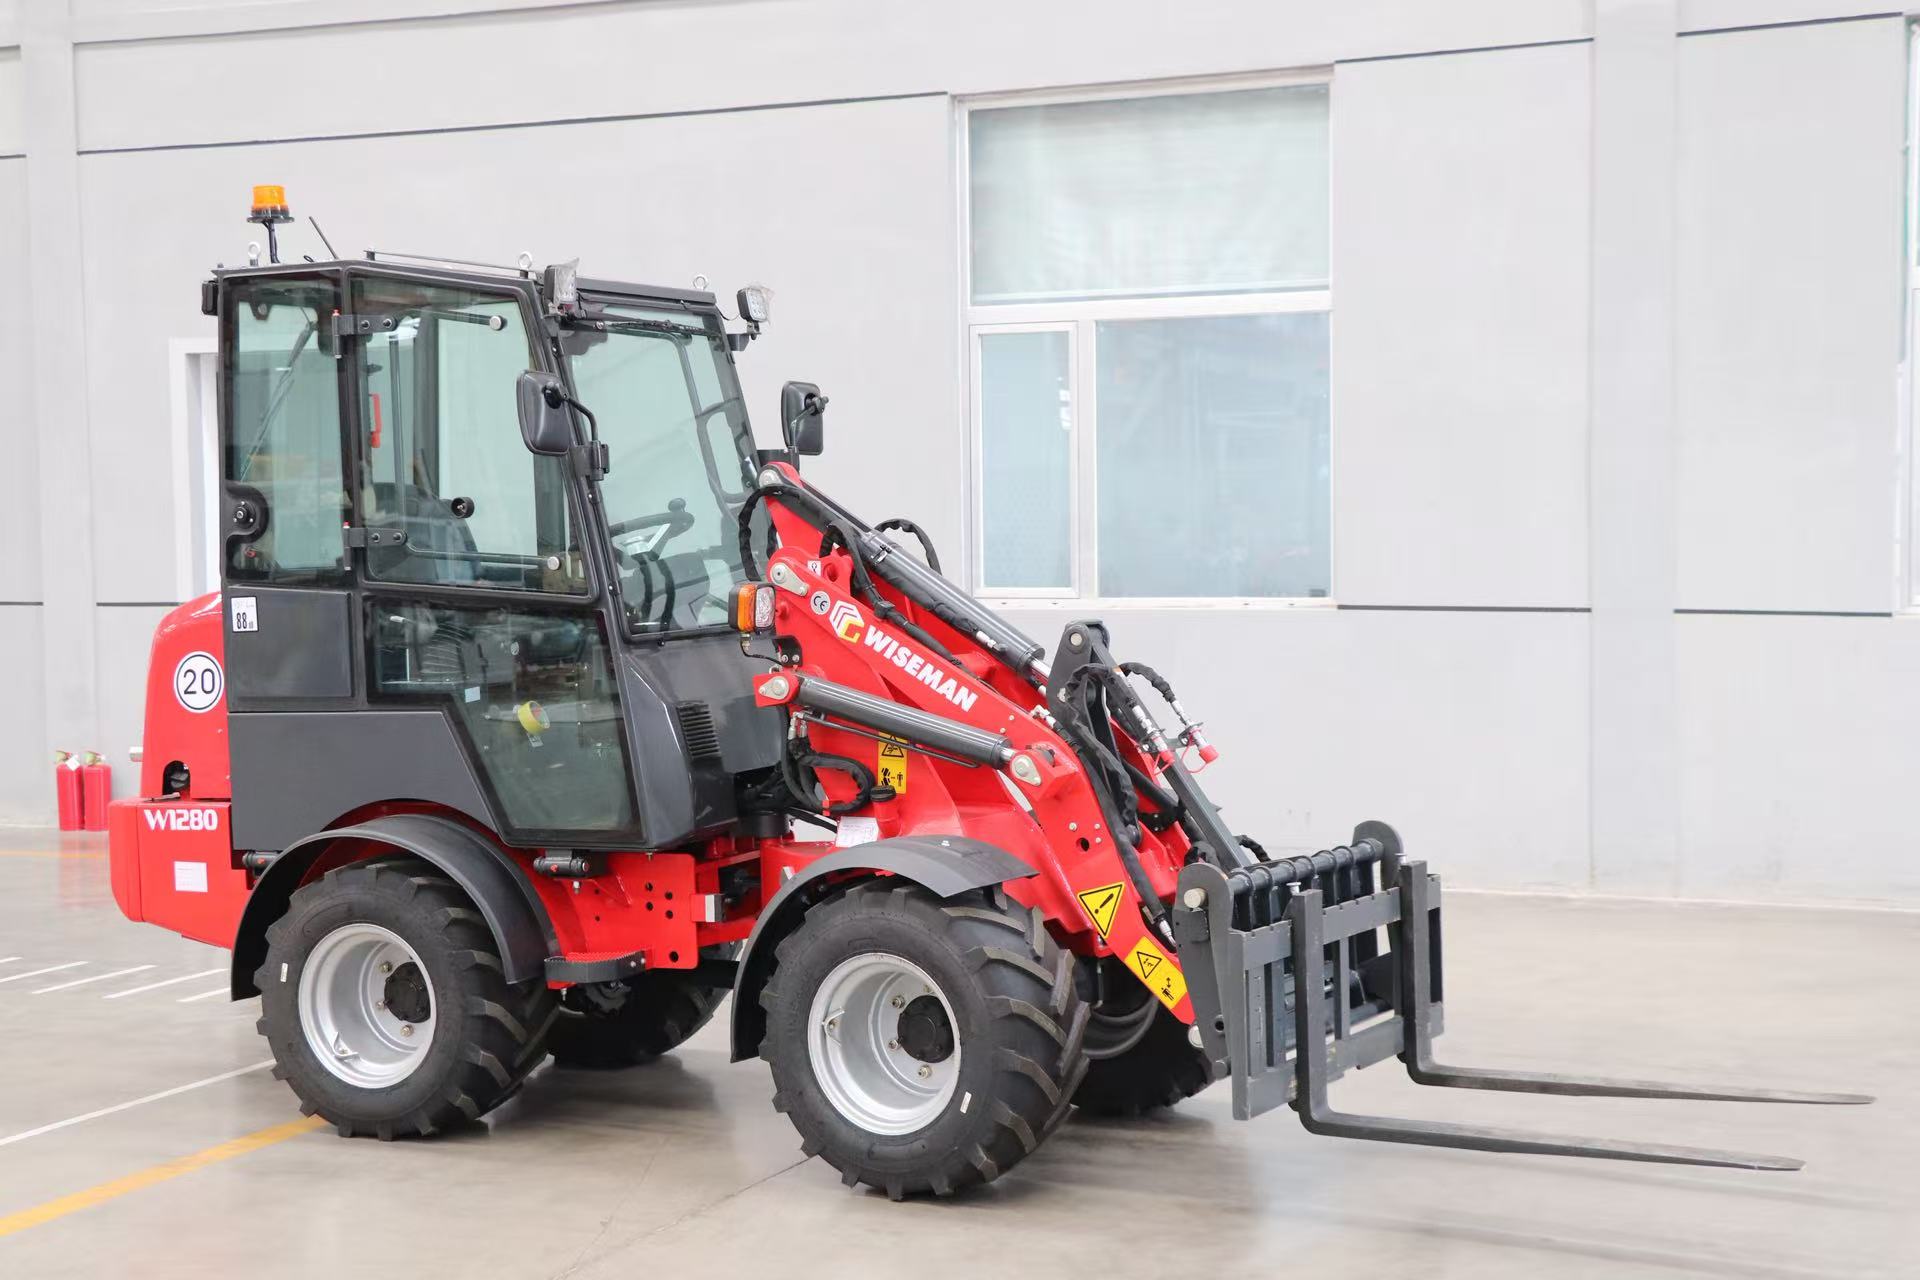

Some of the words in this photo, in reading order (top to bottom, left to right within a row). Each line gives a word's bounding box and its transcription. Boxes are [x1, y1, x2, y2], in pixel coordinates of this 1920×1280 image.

[813, 595, 828, 612] CE
[236, 612, 247, 629] 88
[864, 624, 979, 712] WISEMAN
[183, 668, 215, 694] 20
[144, 809, 218, 831] W1280
